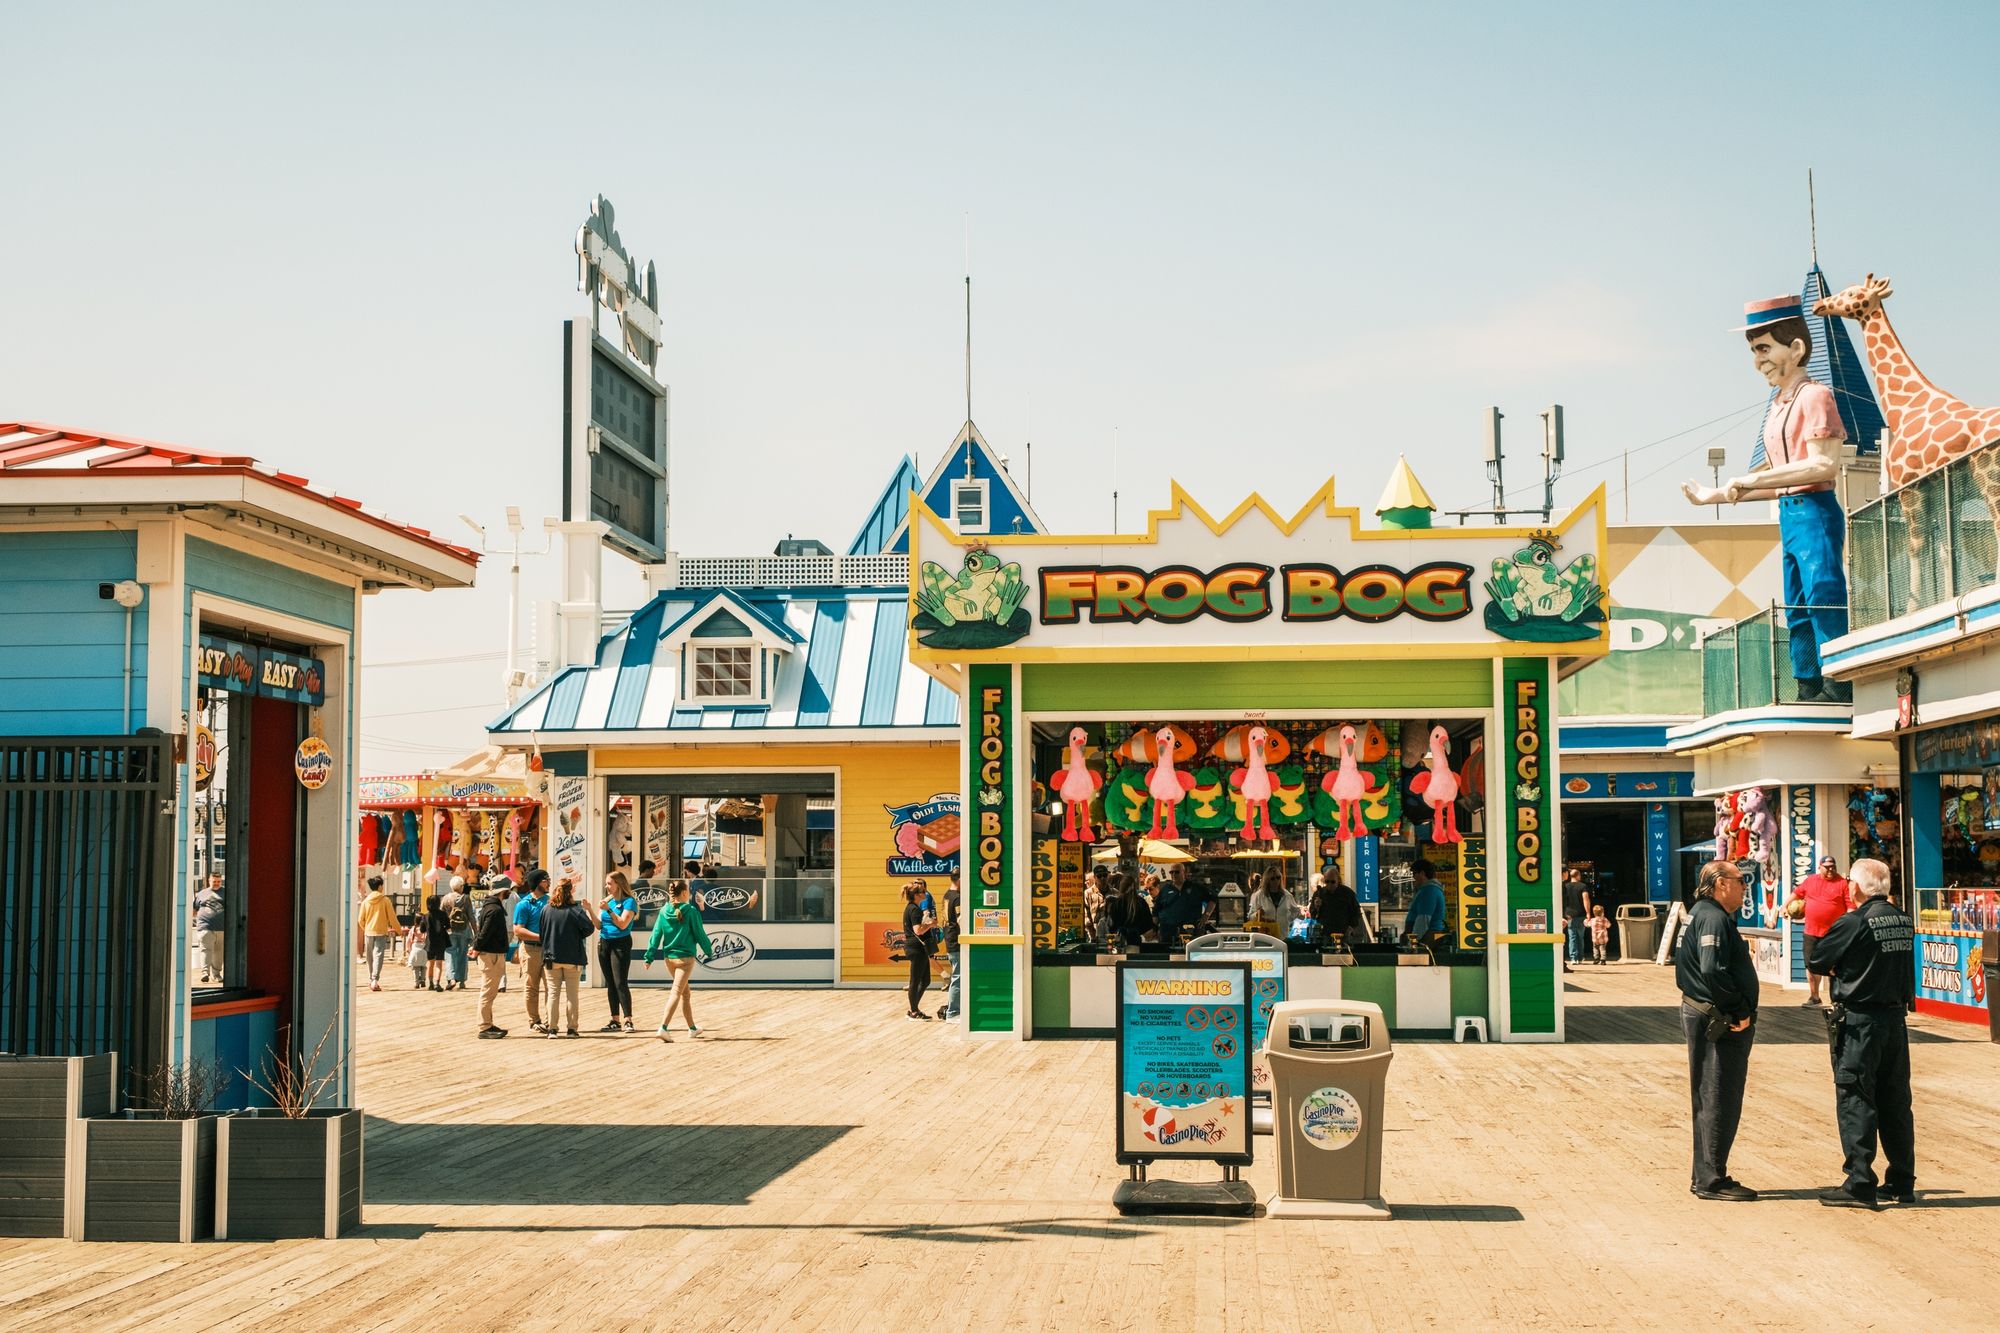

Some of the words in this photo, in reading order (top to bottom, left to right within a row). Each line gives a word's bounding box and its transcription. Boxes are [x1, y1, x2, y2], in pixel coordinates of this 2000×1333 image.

[1039, 563, 1274, 624] FROG
[1281, 562, 1474, 624] BOG
[199, 647, 225, 675] ASY
[262, 660, 297, 688] EASY
[980, 688, 1003, 785] FROG
[1515, 681, 1539, 780] FROG
[301, 768, 327, 782] Candy
[557, 792, 585, 810] CUSTARD
[558, 784, 583, 800] FROZEN
[979, 812, 1003, 886] BOG
[1516, 807, 1540, 882] BOG
[893, 860, 933, 873] Waffles
[934, 860, 949, 873] &
[1654, 832, 1664, 886] WAVES
[1363, 863, 1371, 900] GRILL
[708, 889, 746, 907] Kohr's
[1868, 915, 1899, 928] CASINO
[1900, 915, 1913, 926] PIE
[1873, 927, 1913, 942] EMERGENC
[1881, 940, 1912, 953] SERVICES
[1922, 941, 1958, 966] WORLD
[1136, 979, 1232, 996] WARNING
[1921, 966, 1961, 992] FAMOUS
